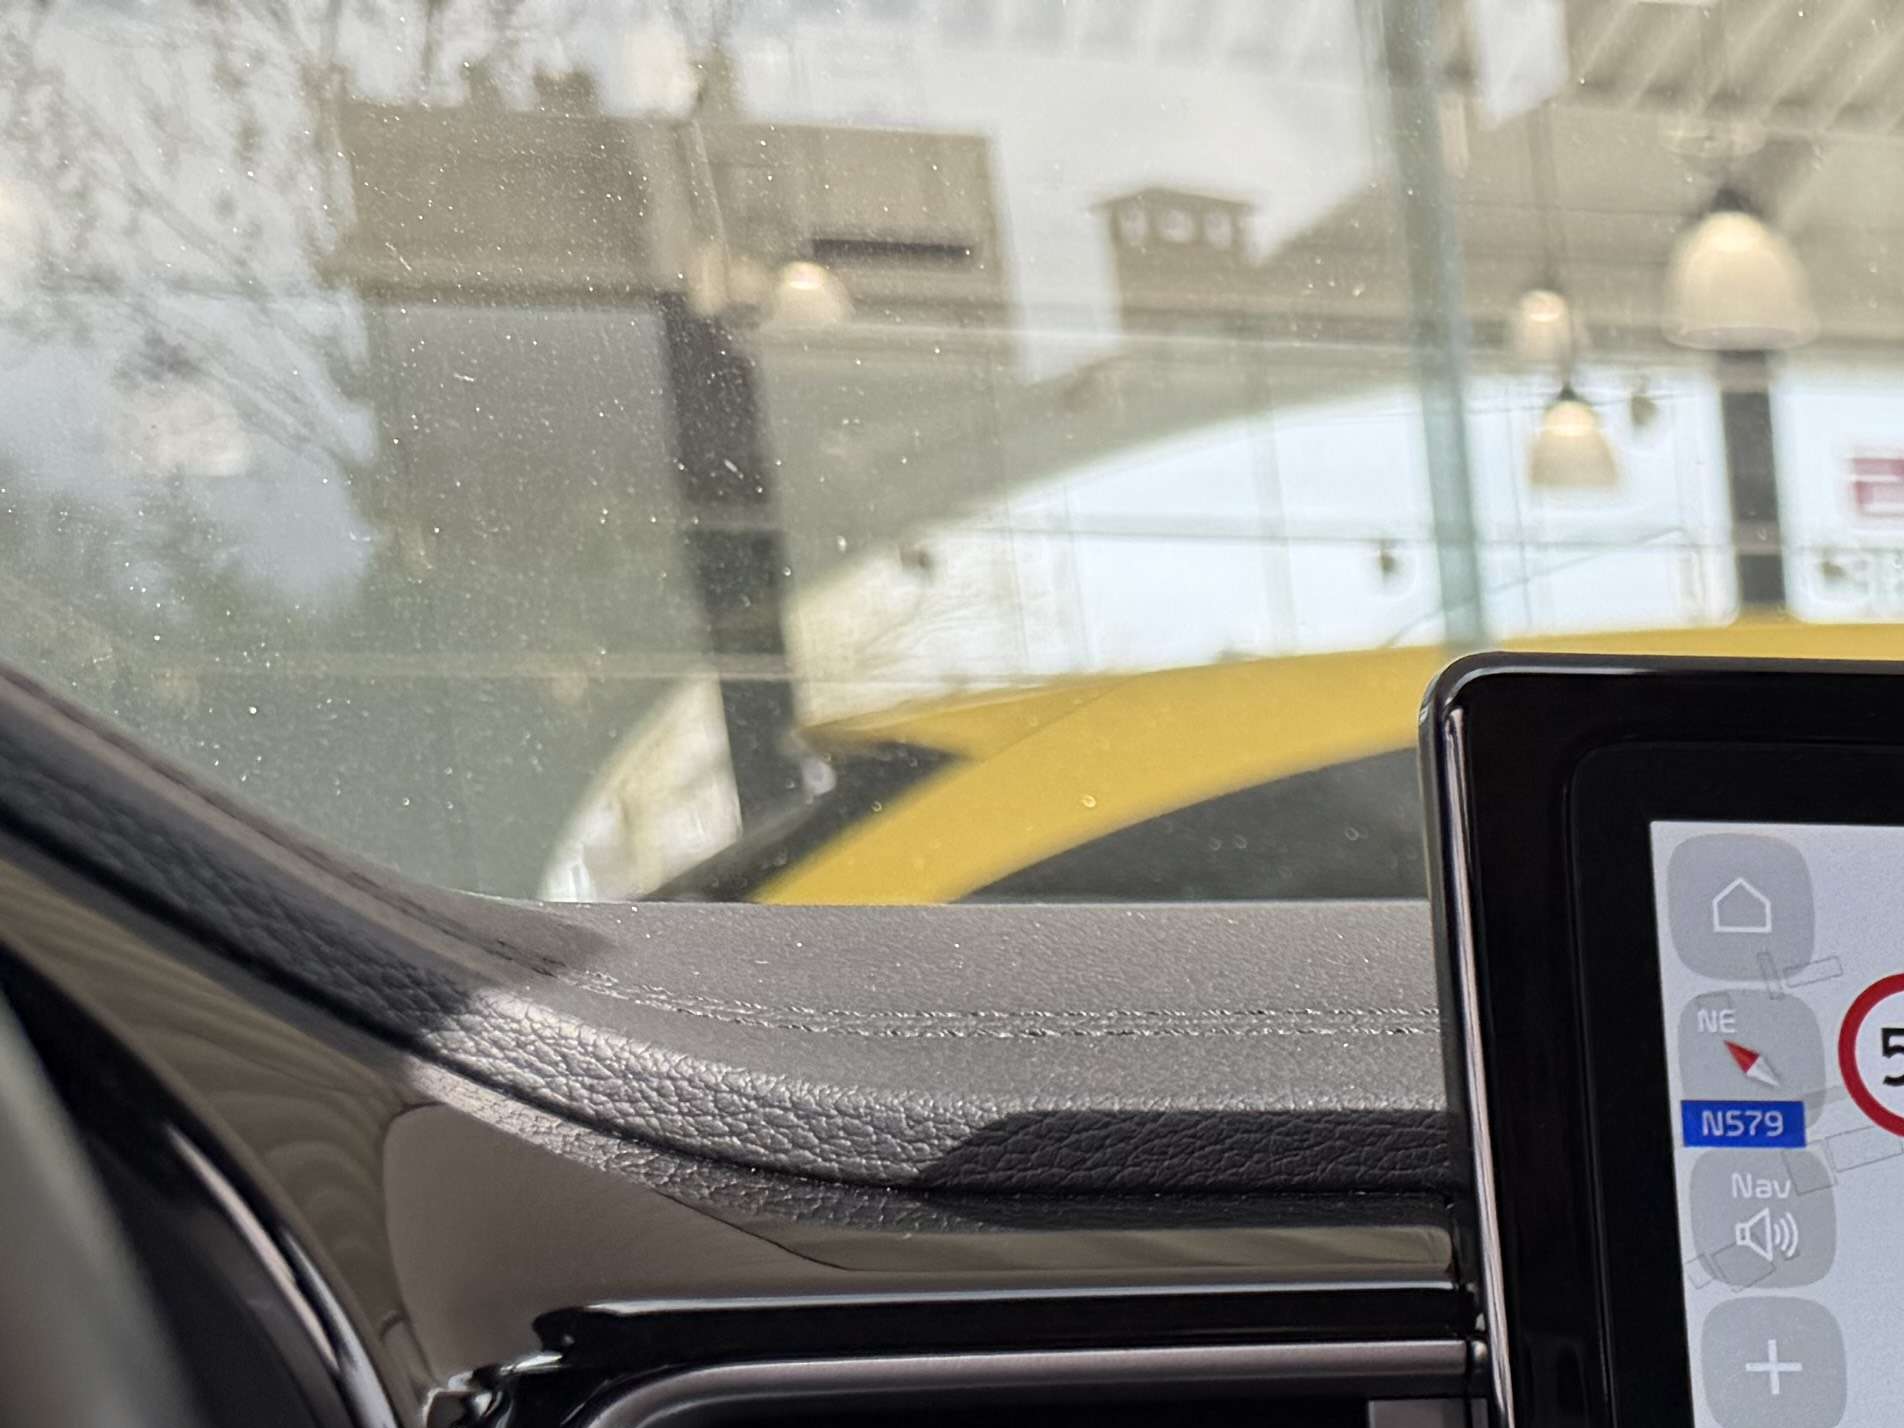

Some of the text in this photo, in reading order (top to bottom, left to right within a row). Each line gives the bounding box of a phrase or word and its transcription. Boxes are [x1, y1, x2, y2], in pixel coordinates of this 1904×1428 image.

[1696, 1009, 1737, 1035] NE
[1701, 1109, 1786, 1140] N579
[1731, 1172, 1792, 1200] Nav
